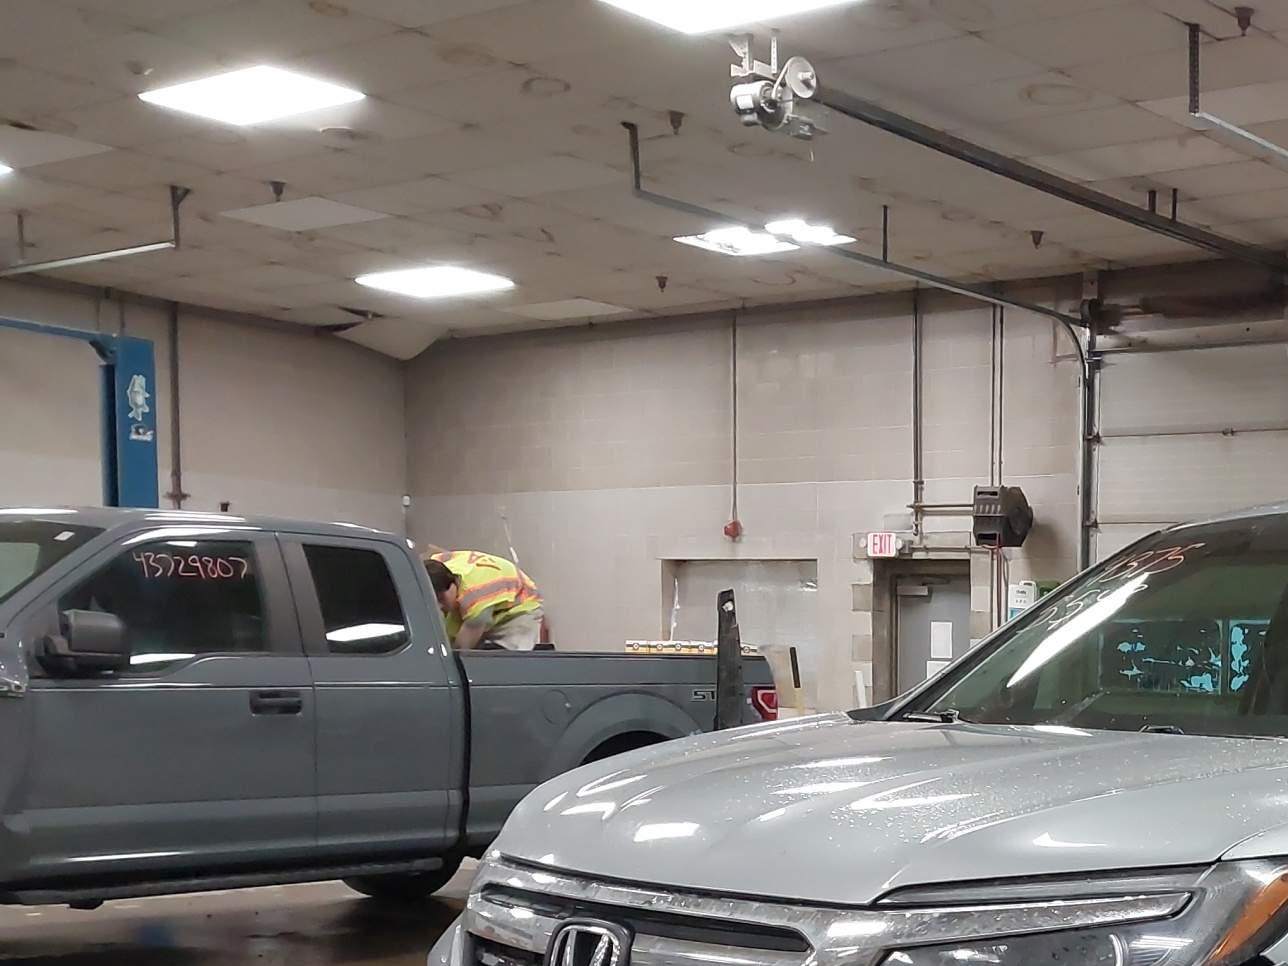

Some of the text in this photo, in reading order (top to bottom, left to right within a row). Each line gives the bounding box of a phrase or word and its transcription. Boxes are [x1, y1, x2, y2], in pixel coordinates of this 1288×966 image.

[873, 533, 892, 554] EXIT
[132, 550, 248, 579] 43729807
[692, 689, 716, 701] ST
